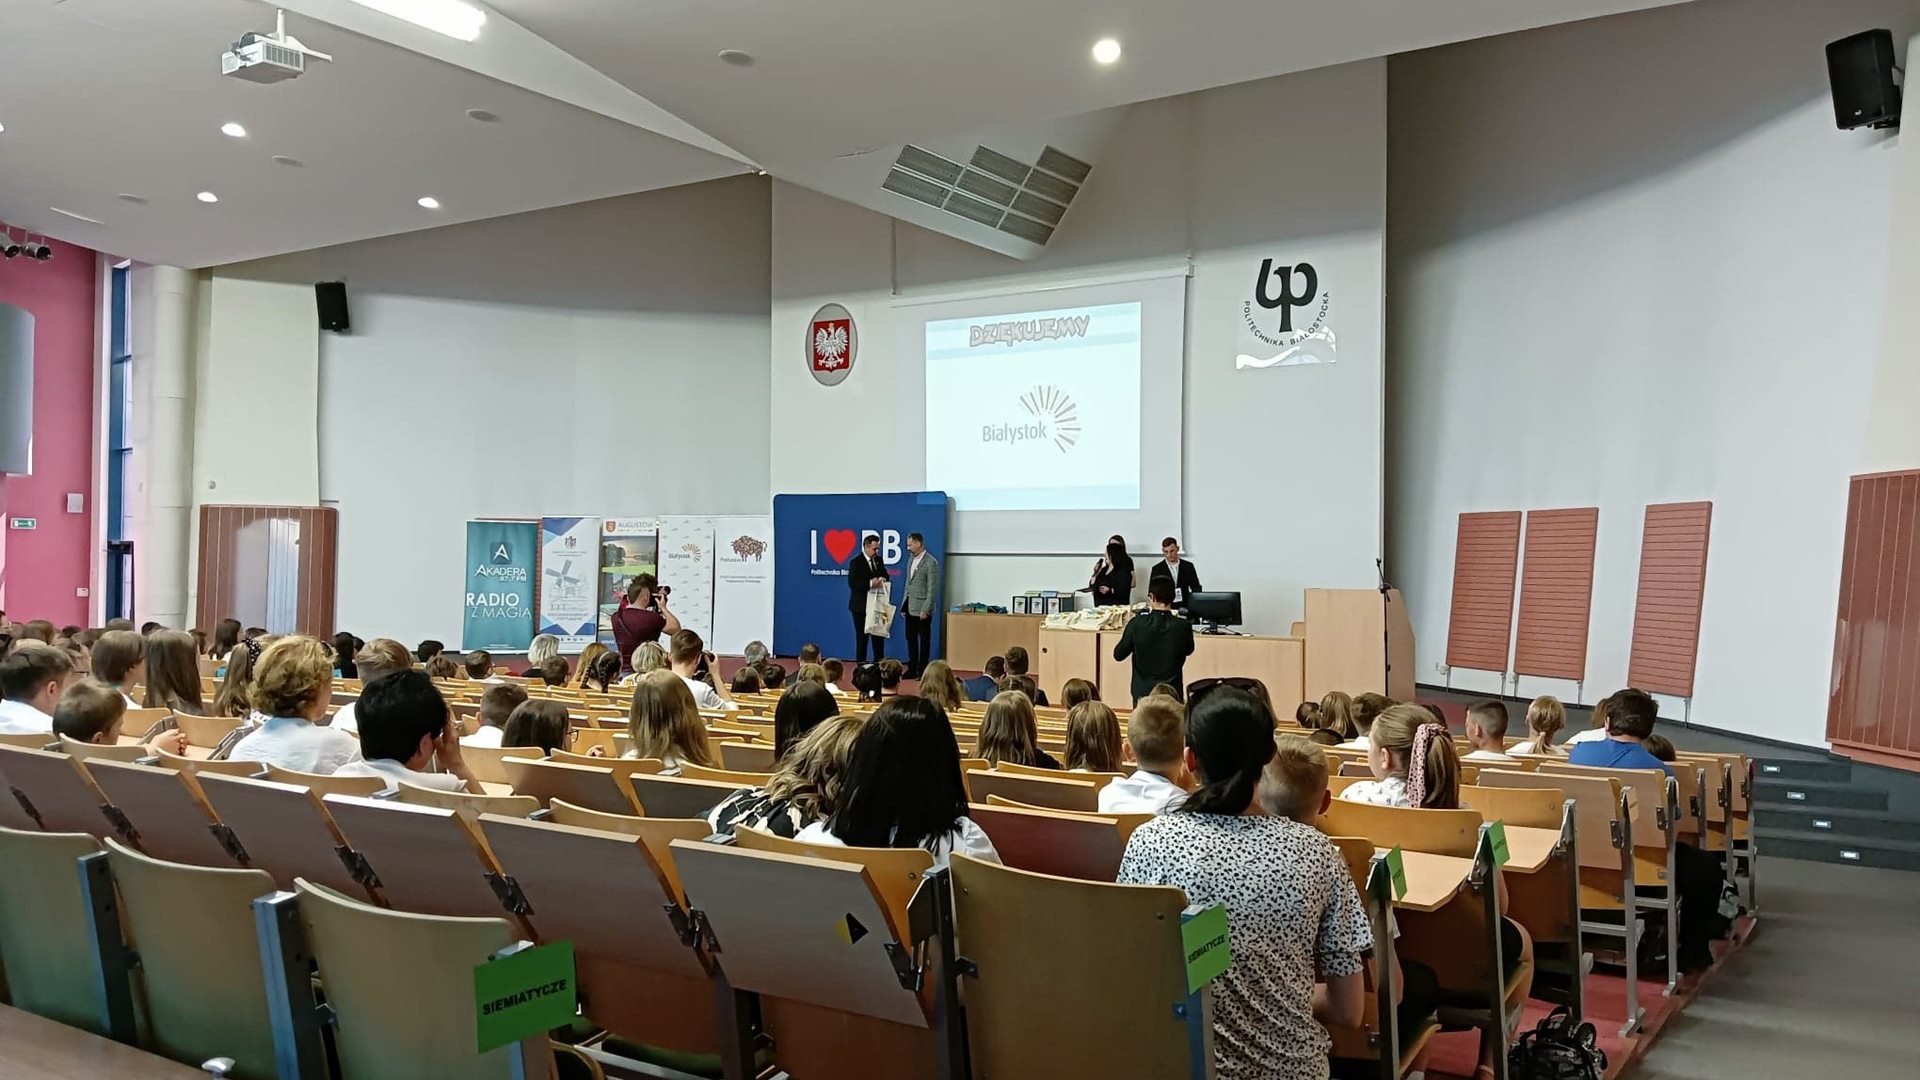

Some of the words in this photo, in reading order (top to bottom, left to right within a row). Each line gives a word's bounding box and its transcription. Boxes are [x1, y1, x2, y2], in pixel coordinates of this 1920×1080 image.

[970, 315, 1090, 347] DZIĘKUJEMY
[1244, 301, 1284, 346] POLITECHNIKA
[1290, 292, 1329, 345] BIAŁOSTOCKA
[811, 529, 817, 565] I
[474, 564, 527, 576] AKADERA
[466, 592, 519, 607] RADIO
[472, 606, 477, 618] Z
[482, 979, 567, 1016] SIEMIATYCZE
